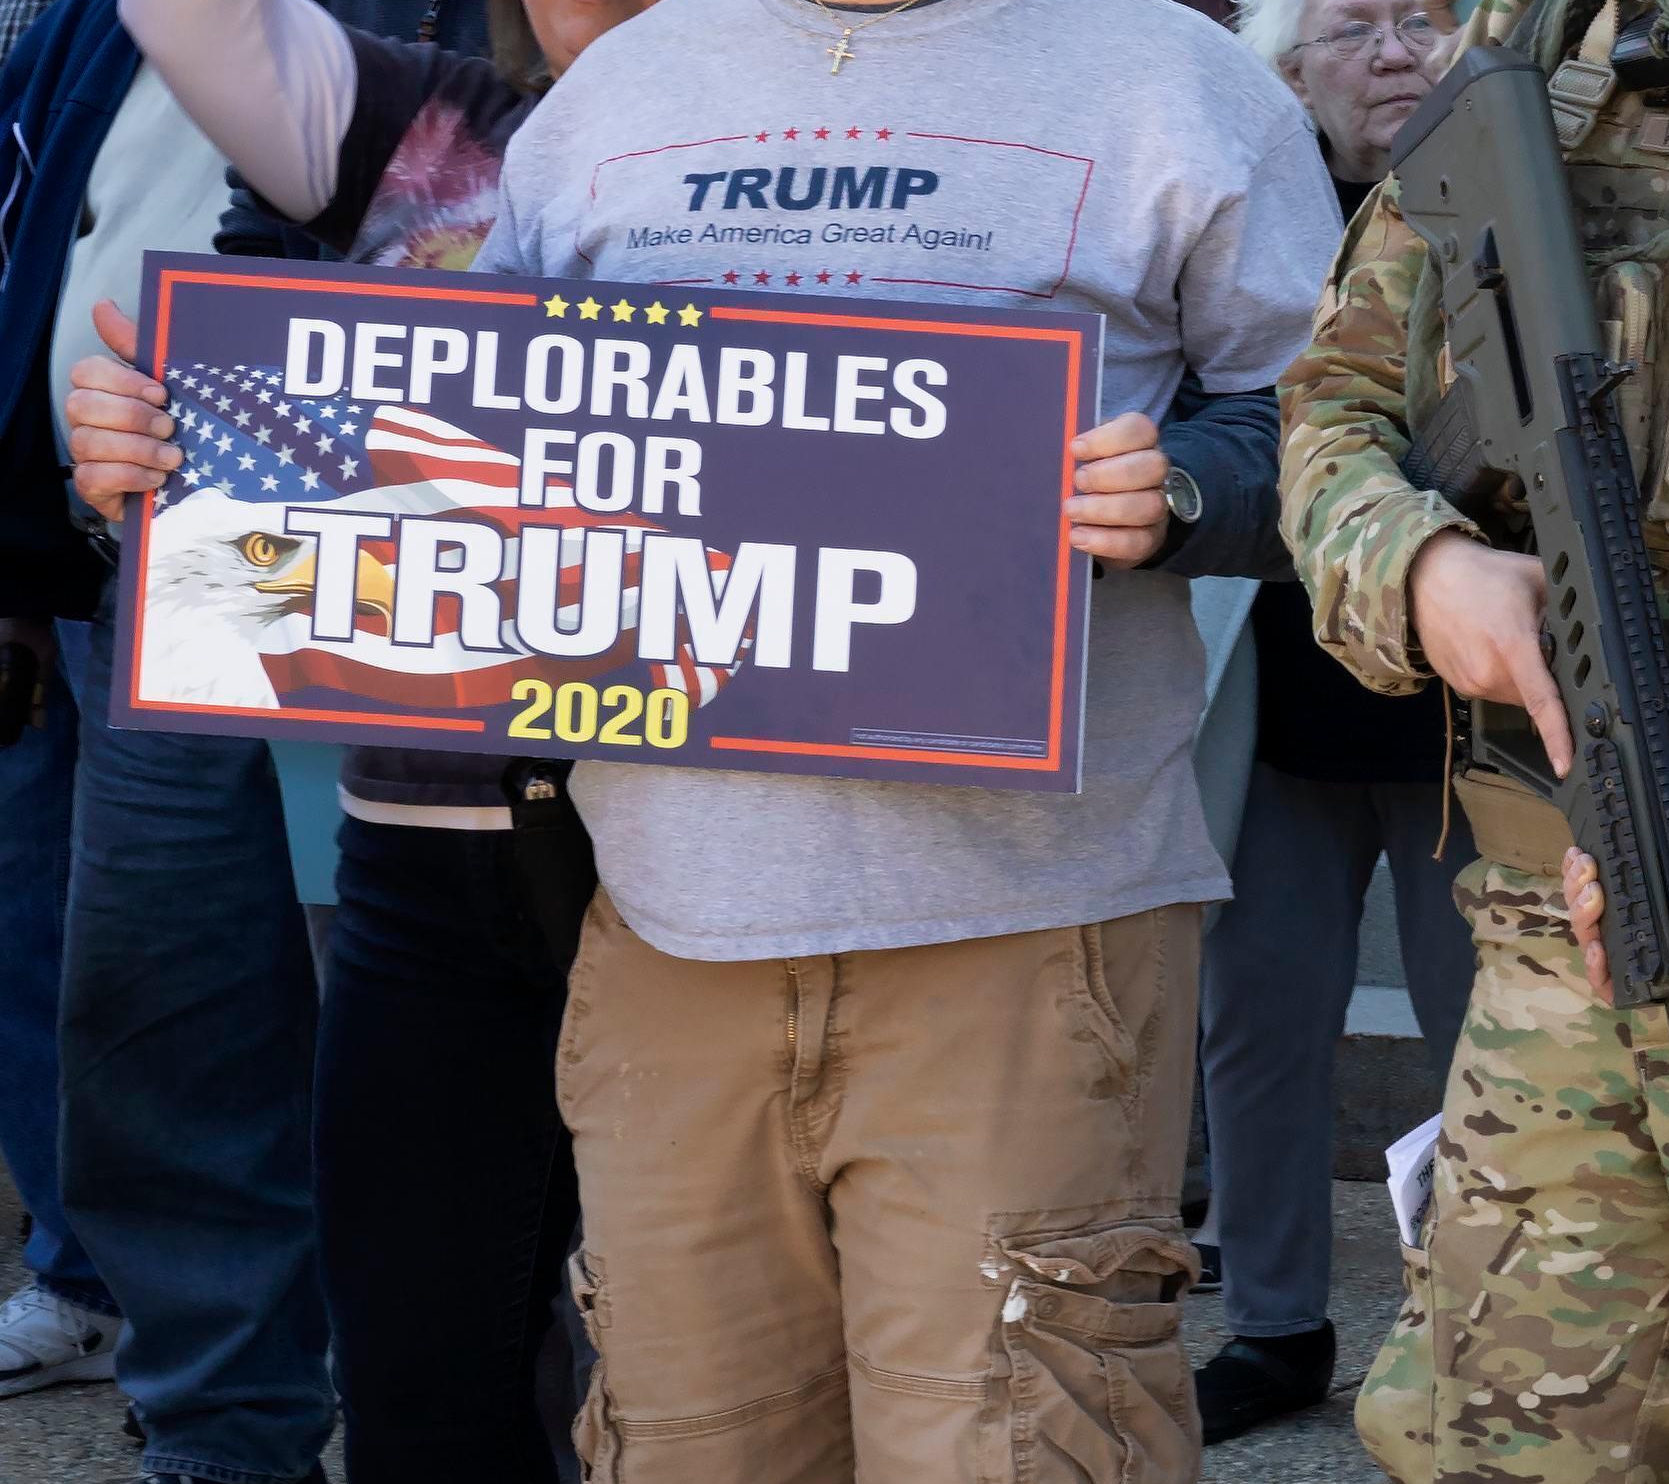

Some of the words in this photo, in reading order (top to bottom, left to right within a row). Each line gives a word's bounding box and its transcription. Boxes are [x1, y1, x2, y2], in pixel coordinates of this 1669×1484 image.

[682, 165, 940, 212] TRUMP
[625, 225, 693, 250] Make
[700, 223, 812, 246] America
[821, 221, 895, 244] Great
[901, 224, 994, 252] Again!
[283, 317, 949, 441] DEPLORABLES
[518, 427, 704, 518] FOR
[283, 507, 920, 674] TRUMP
[506, 677, 692, 750] 2020
